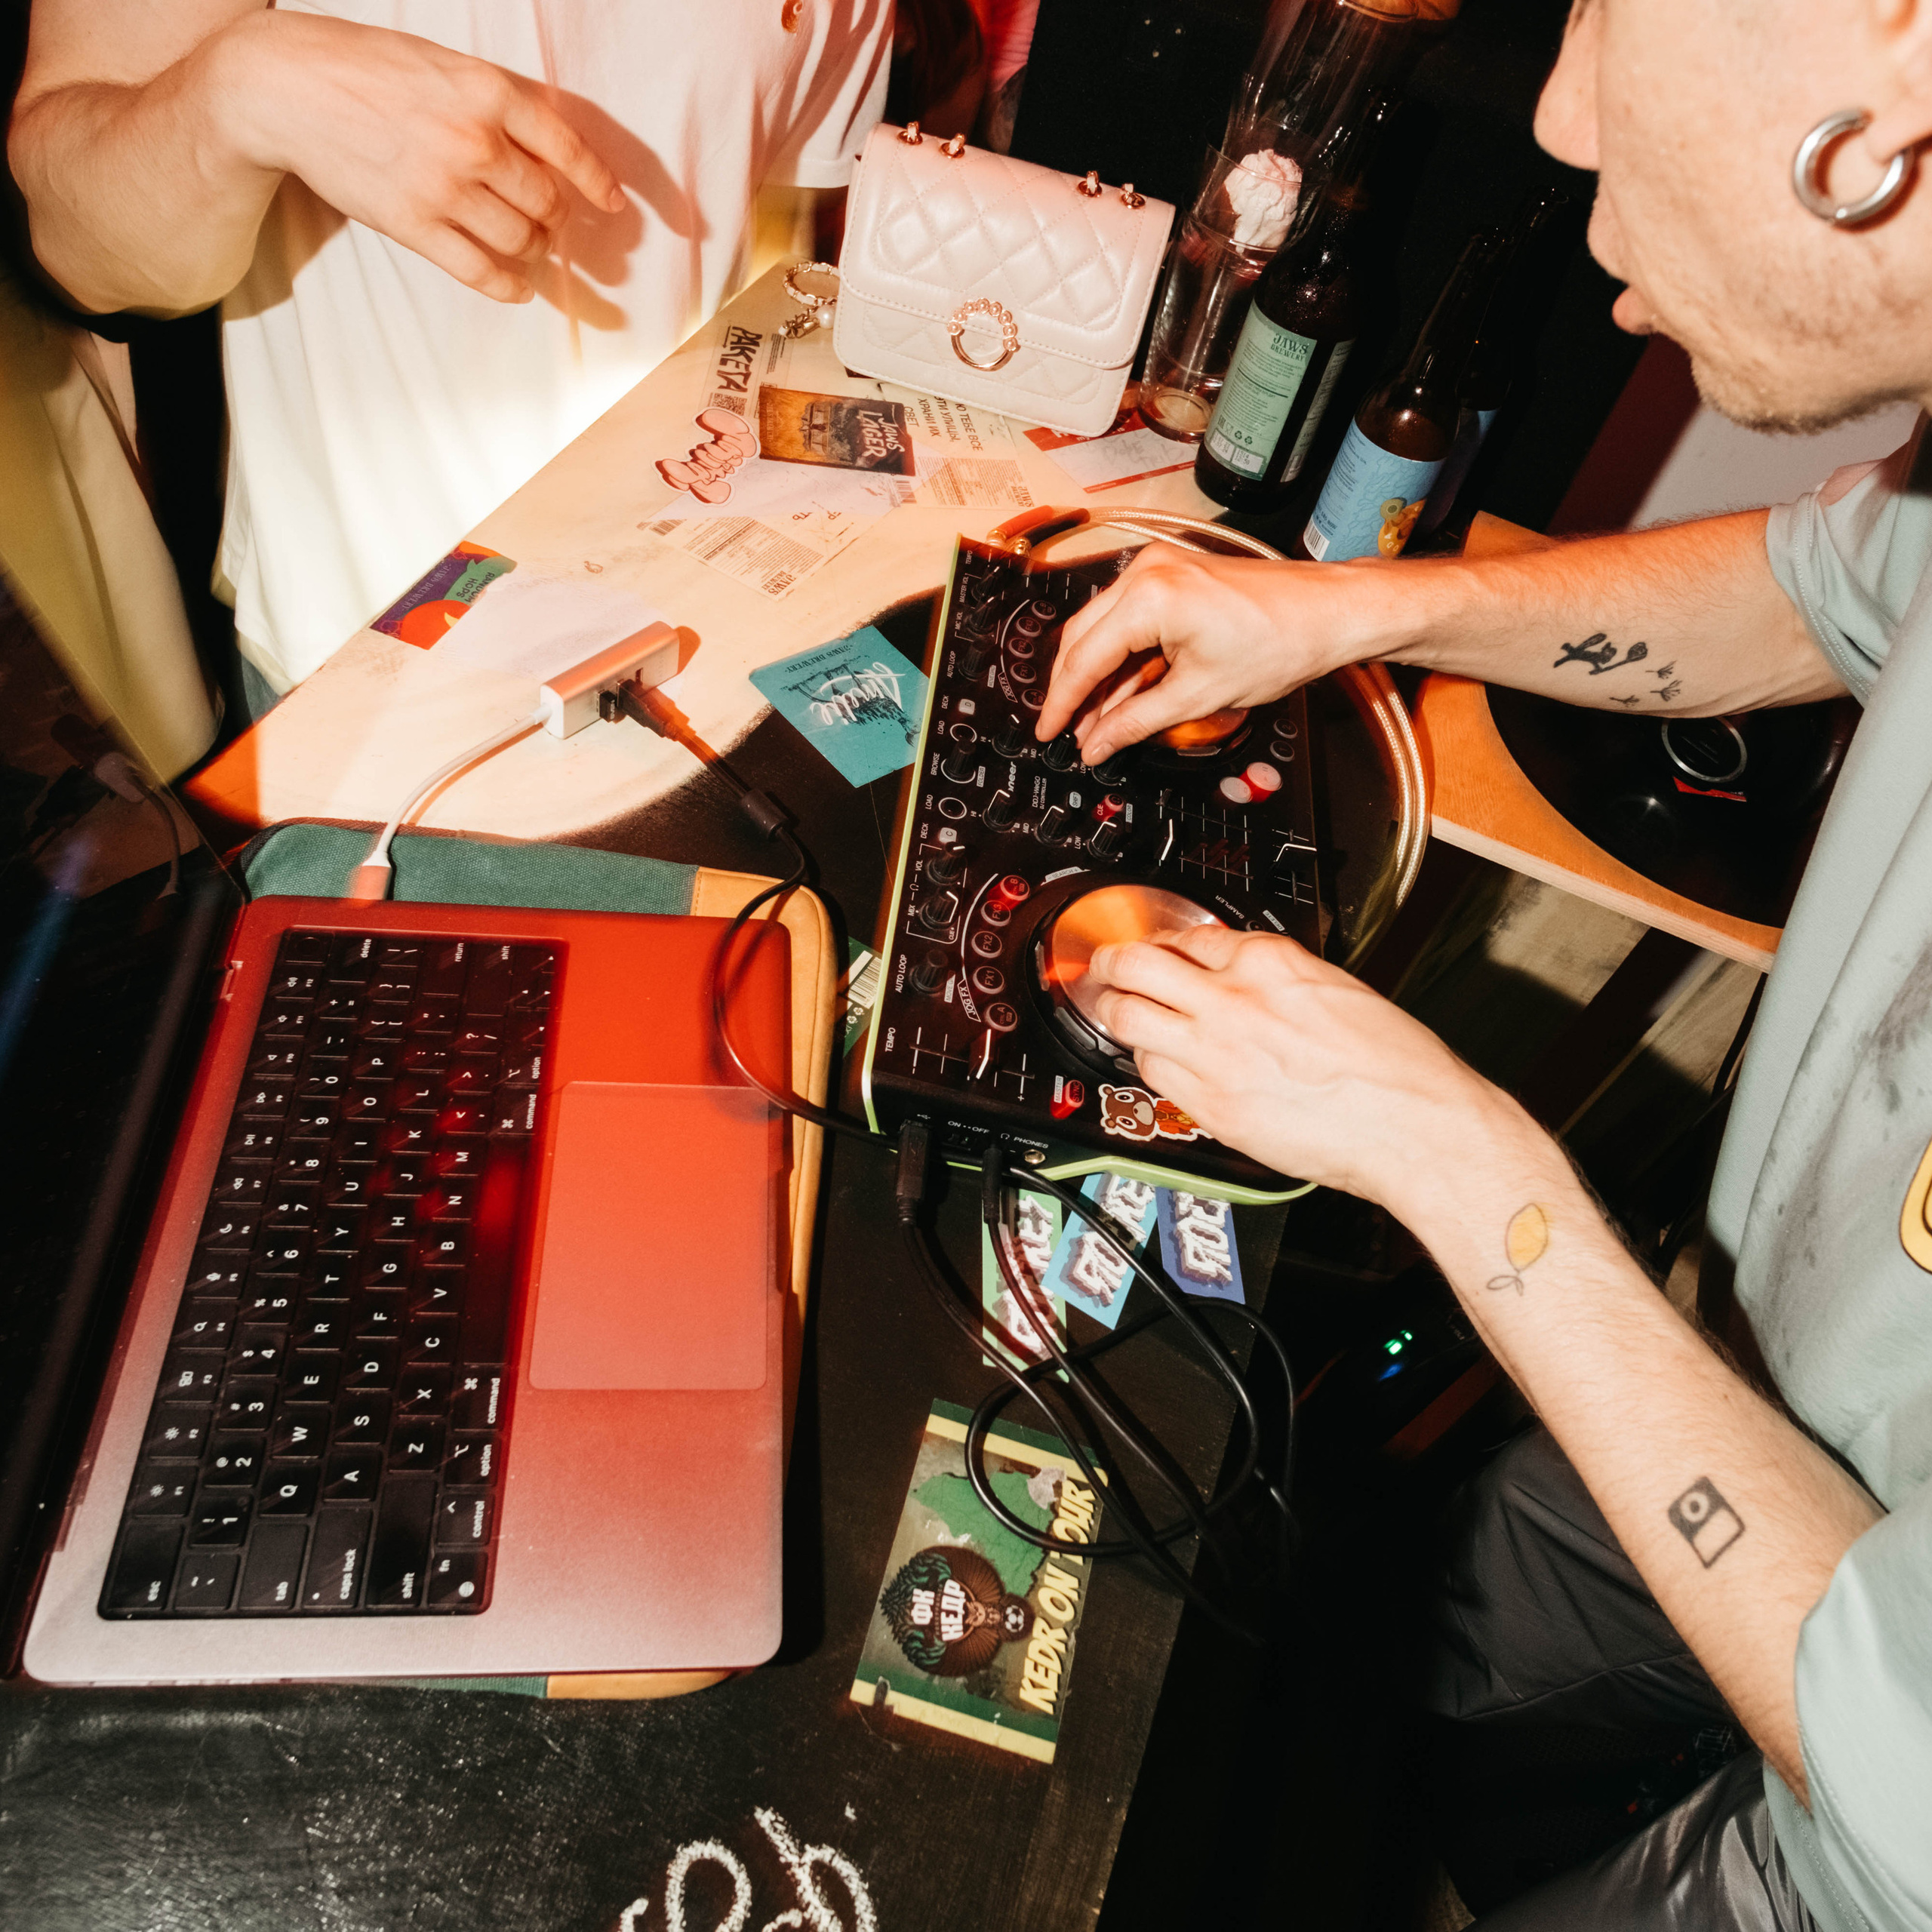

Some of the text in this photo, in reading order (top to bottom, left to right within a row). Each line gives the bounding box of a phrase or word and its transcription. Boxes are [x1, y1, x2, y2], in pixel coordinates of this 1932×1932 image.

[1273, 334, 1309, 355] JAWS
[1270, 345, 1305, 361] BREWERY
[904, 407, 918, 427] СВЕТ
[918, 398, 941, 437] ХРАНИ ИХ
[857, 409, 888, 457] LAGER
[881, 417, 904, 453] JAWS
[959, 414, 976, 433] ТЕБЕ
[968, 434, 983, 451] ВСЕ
[457, 578, 478, 598] HOPS
[768, 574, 795, 595] JAWS
[787, 645, 853, 672] JAWS BREWERY
[1020, 666, 1028, 678] FX1
[931, 752, 940, 775] BROWSE
[1008, 761, 1017, 792] neer
[924, 795, 933, 809] LOAD
[992, 904, 1002, 919] FX3
[1215, 895, 1244, 918] SAMPLER
[360, 938, 372, 958] delete
[983, 935, 993, 950] FX2
[454, 943, 464, 962] return
[501, 946, 510, 960] shift
[895, 955, 906, 992] AUTO LOOP
[985, 970, 995, 986] FX1
[961, 986, 975, 1015] JOG FX
[885, 1028, 896, 1052] TEMPO
[371, 1057, 384, 1066] P
[531, 1057, 541, 1079] option
[1071, 1081, 1081, 1102] SYNC
[363, 1097, 377, 1106] O
[525, 1094, 537, 1130] command
[315, 1117, 329, 1125] 9
[408, 1130, 422, 1138] K
[1014, 1137, 1048, 1148] PHONES
[305, 1159, 319, 1168] 8
[455, 1152, 469, 1162] M
[344, 1182, 359, 1191] U
[448, 1195, 463, 1205] N
[391, 1217, 405, 1226] H
[334, 1227, 349, 1236] Y
[440, 1241, 455, 1251] B
[284, 1249, 299, 1259] 6
[382, 1263, 397, 1273] G
[325, 1274, 340, 1284] T
[433, 1287, 448, 1298] V
[272, 1298, 288, 1307] 5
[373, 1312, 388, 1321] F
[314, 1323, 330, 1333] R
[425, 1337, 440, 1348] C
[261, 1349, 276, 1359] 4
[363, 1361, 379, 1373] D
[303, 1375, 320, 1385] E
[417, 1389, 432, 1399] X
[487, 1377, 501, 1424] command
[248, 1401, 264, 1412] 3
[353, 1415, 370, 1426] S
[291, 1426, 308, 1442] W
[408, 1443, 424, 1454] Z
[235, 1457, 252, 1467] 2
[480, 1444, 492, 1477] option
[343, 1470, 360, 1482] A
[279, 1484, 298, 1497] Q
[472, 1500, 485, 1538] control
[438, 1559, 451, 1573] fn
[339, 1549, 356, 1600] caps lock
[147, 1581, 162, 1601] esc
[275, 1581, 288, 1601] tab
[401, 1572, 415, 1599] shift
[1038, 1562, 1080, 1622] ON
[911, 1589, 934, 1626] ФК
[940, 1579, 966, 1641] КЕДР
[1019, 1617, 1067, 1714] KEDR
